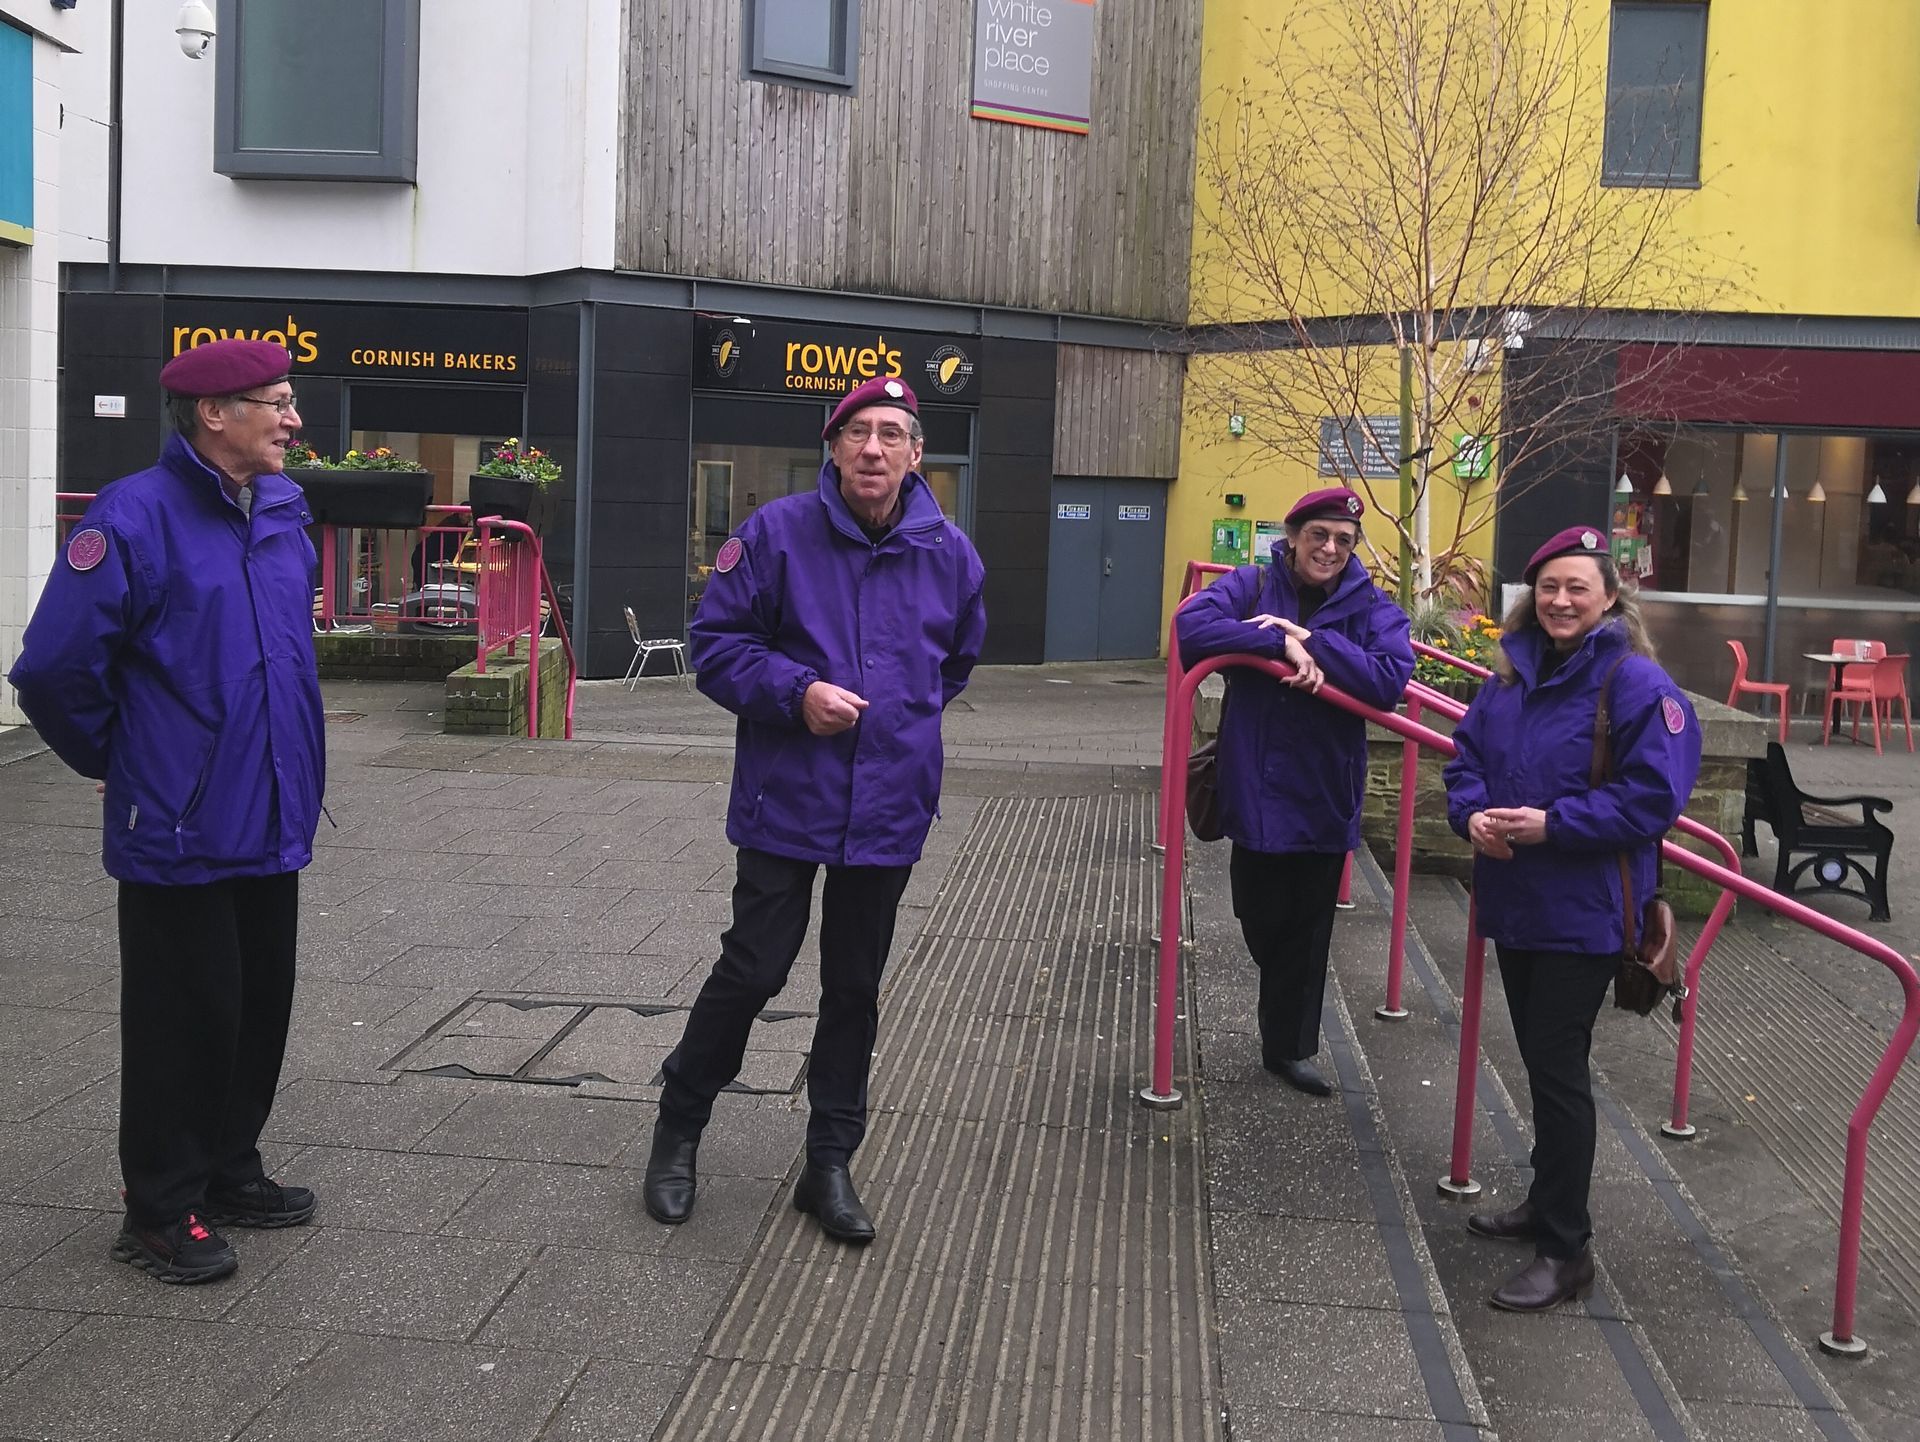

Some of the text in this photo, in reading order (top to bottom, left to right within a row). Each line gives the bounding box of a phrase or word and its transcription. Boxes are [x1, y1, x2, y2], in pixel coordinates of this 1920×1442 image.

[988, 0, 1052, 27] white
[986, 19, 1038, 48] river
[984, 45, 1050, 76] place
[984, 79, 1048, 97] SHOPPING CENTRE
[351, 349, 435, 367] CORNISH
[444, 352, 517, 371] BAKERS
[786, 335, 902, 378] rowe's
[785, 375, 846, 392] CORNISH
